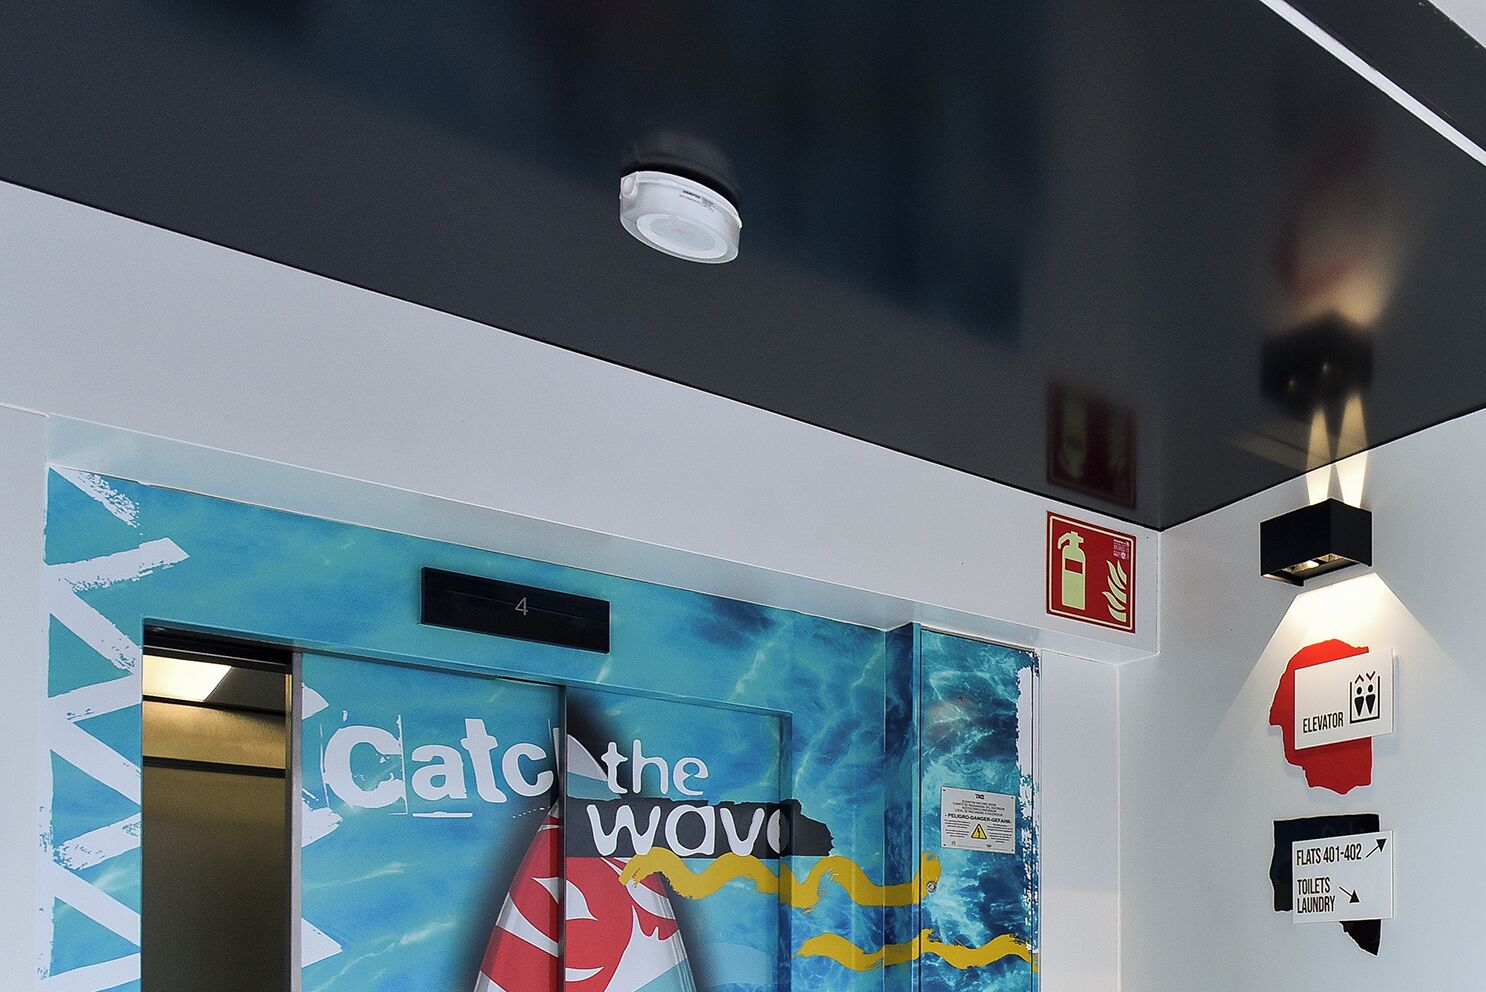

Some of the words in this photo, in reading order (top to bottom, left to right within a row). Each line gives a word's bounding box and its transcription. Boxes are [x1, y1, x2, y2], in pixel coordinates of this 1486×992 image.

[515, 597, 528, 616] 4
[1302, 711, 1344, 734] ELEVATOR
[323, 718, 560, 810] Catc
[601, 739, 710, 796] the
[1296, 847, 1321, 866] FLATS
[1322, 843, 1362, 863] 401-402
[1297, 877, 1331, 896] TOILETS
[1297, 895, 1336, 914] LAUNDRY
